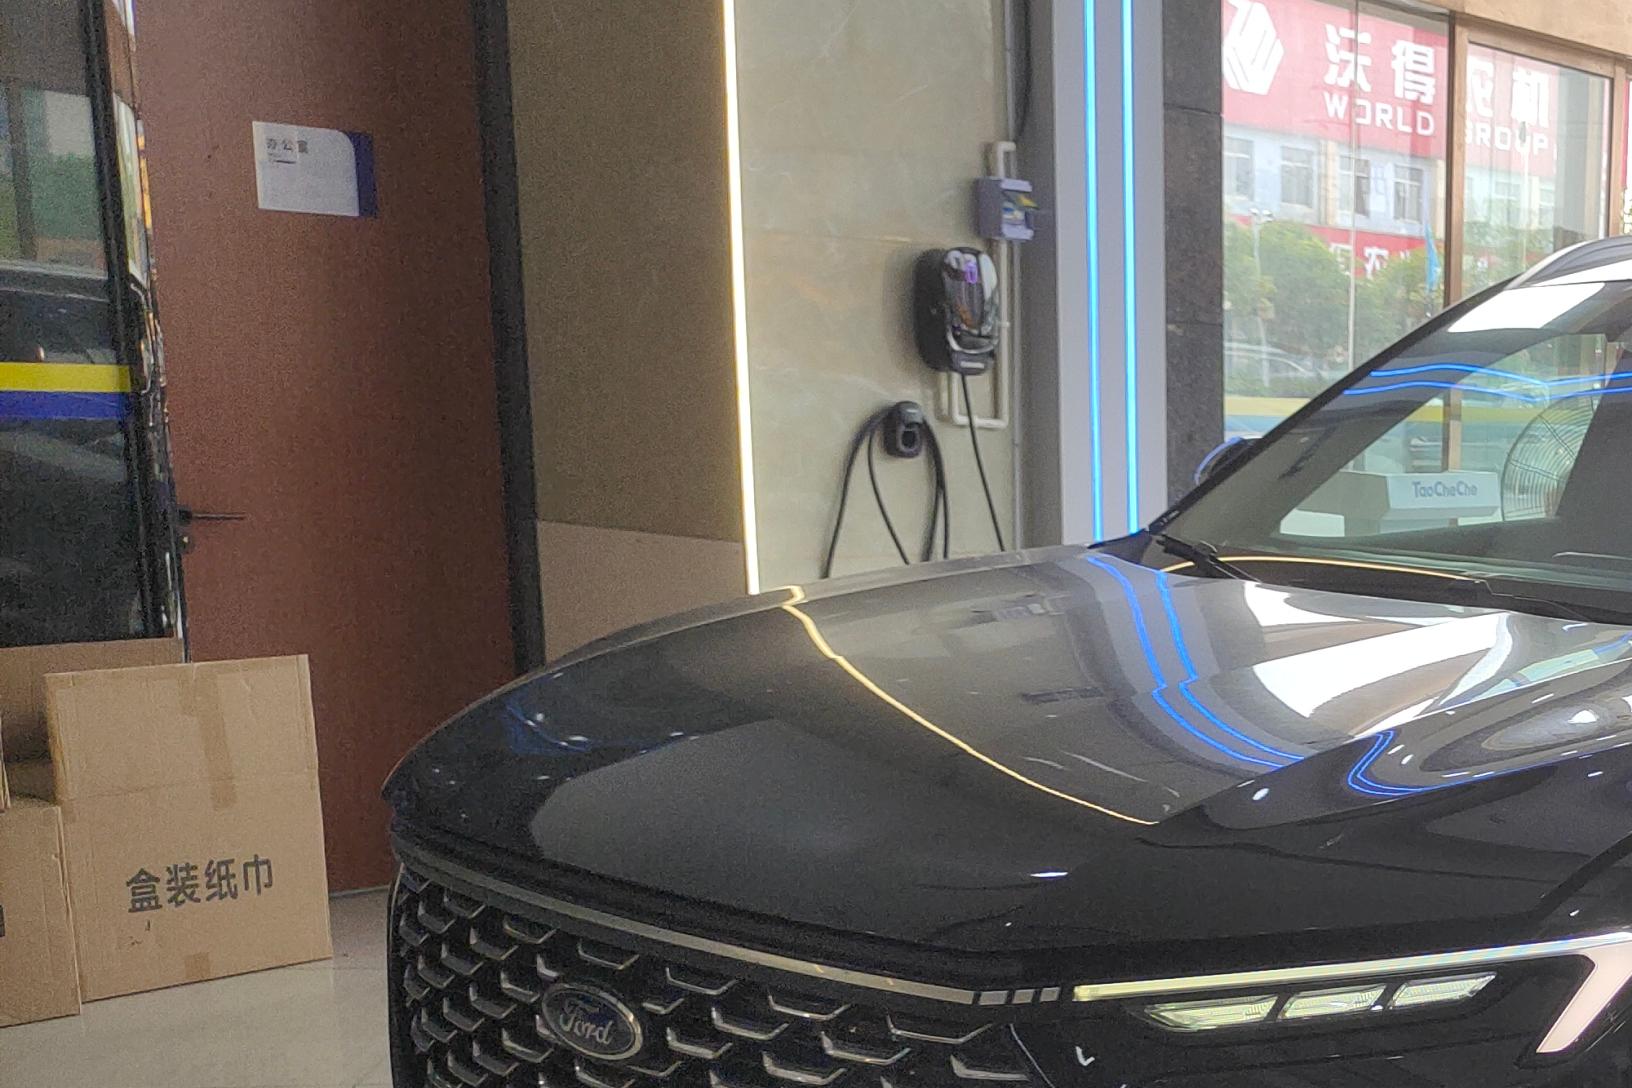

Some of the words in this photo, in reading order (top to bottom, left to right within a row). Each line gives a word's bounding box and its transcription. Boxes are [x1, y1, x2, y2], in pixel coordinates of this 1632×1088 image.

[1322, 91, 1436, 137] WORLD
[1412, 480, 1478, 498] TaoCheChe
[126, 853, 273, 914] 盒装纸巾
[558, 997, 615, 1046] Ford
